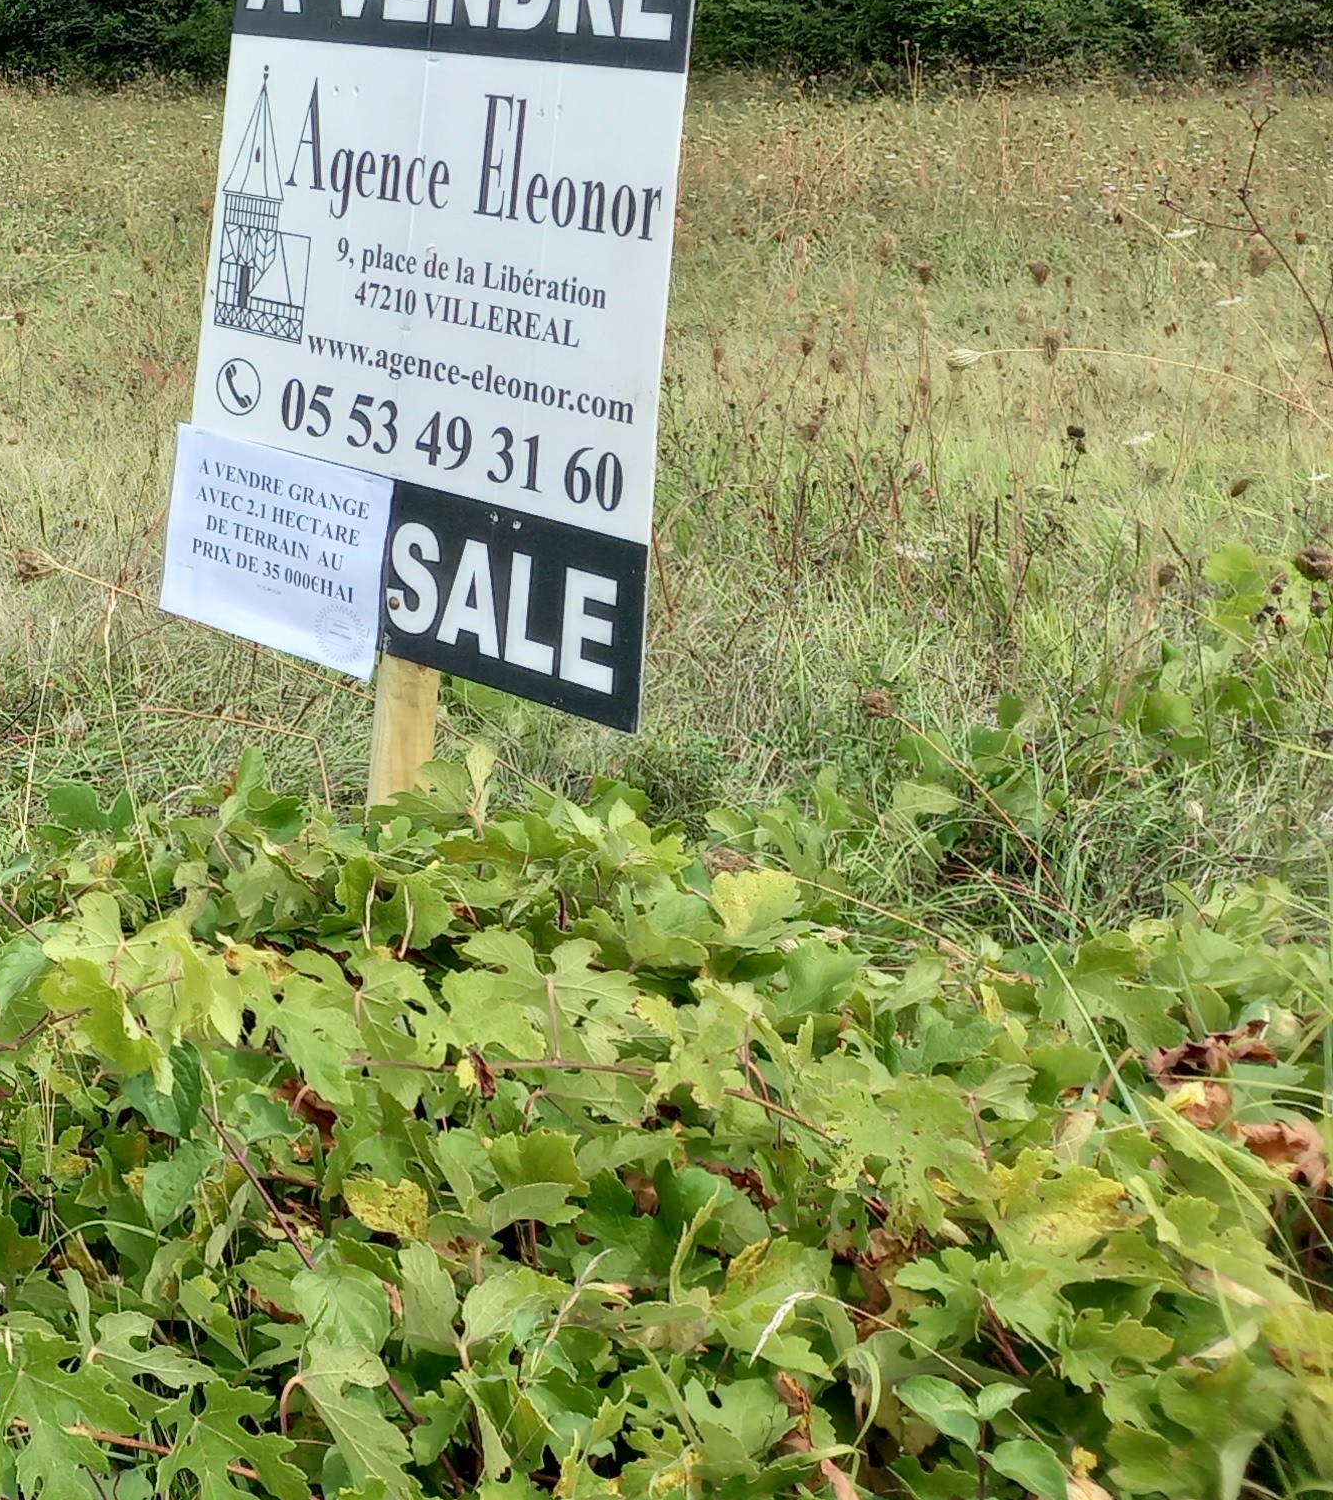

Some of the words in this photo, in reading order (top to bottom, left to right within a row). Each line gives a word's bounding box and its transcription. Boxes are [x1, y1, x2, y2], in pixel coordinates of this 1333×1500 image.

[285, 76, 451, 220] Agence
[473, 93, 664, 242] Eleonor
[337, 236, 354, 269] 9,
[361, 243, 417, 275] place
[424, 252, 449, 280] de
[456, 257, 475, 286] la
[483, 262, 607, 310] Libération
[354, 280, 417, 316] 47210
[424, 292, 581, 348] VILLEREAL
[308, 334, 634, 425] www.agence-eleonor.com
[282, 378, 334, 438] 05
[346, 393, 399, 454] 53
[415, 411, 472, 471] 49
[487, 426, 542, 494] 31
[564, 447, 624, 512] 60
[196, 485, 243, 512] AVEC
[246, 499, 267, 518] 2.1
[272, 507, 360, 547] HECTARE
[198, 459, 210, 475] A
[215, 461, 284, 497] VENDRE
[288, 483, 370, 520] GRANGE
[192, 537, 231, 565] PRIX
[236, 552, 259, 573] DE
[262, 561, 280, 580] 35
[206, 514, 228, 535] DE
[233, 522, 310, 561] TERRAIN
[317, 550, 344, 571] AU
[386, 521, 619, 696] SALE
